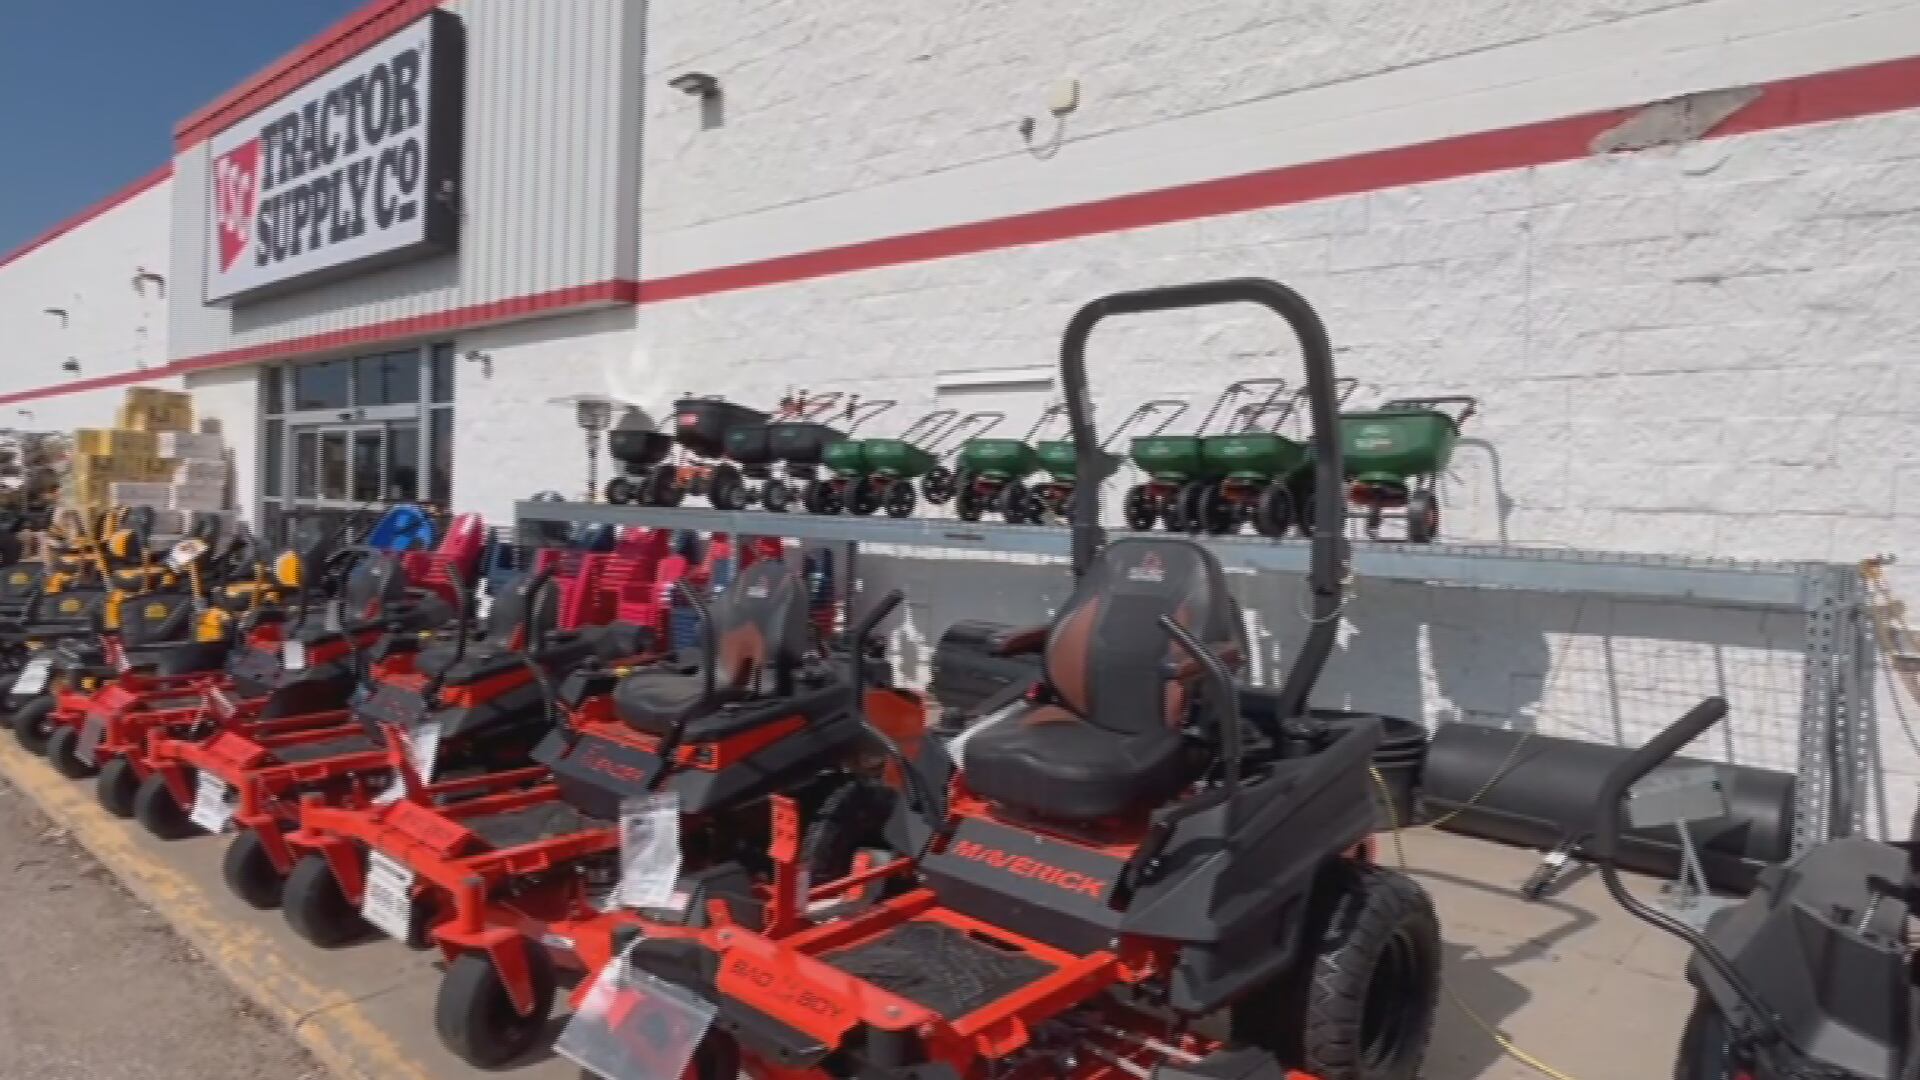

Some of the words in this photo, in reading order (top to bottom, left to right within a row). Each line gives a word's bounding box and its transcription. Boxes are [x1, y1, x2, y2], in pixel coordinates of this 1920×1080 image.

[259, 48, 421, 191] TRACTOR
[254, 155, 373, 268] SUPPLY
[954, 840, 1107, 898] MAVERICK
[729, 958, 776, 988] BAD
[796, 990, 847, 1018] BOY
